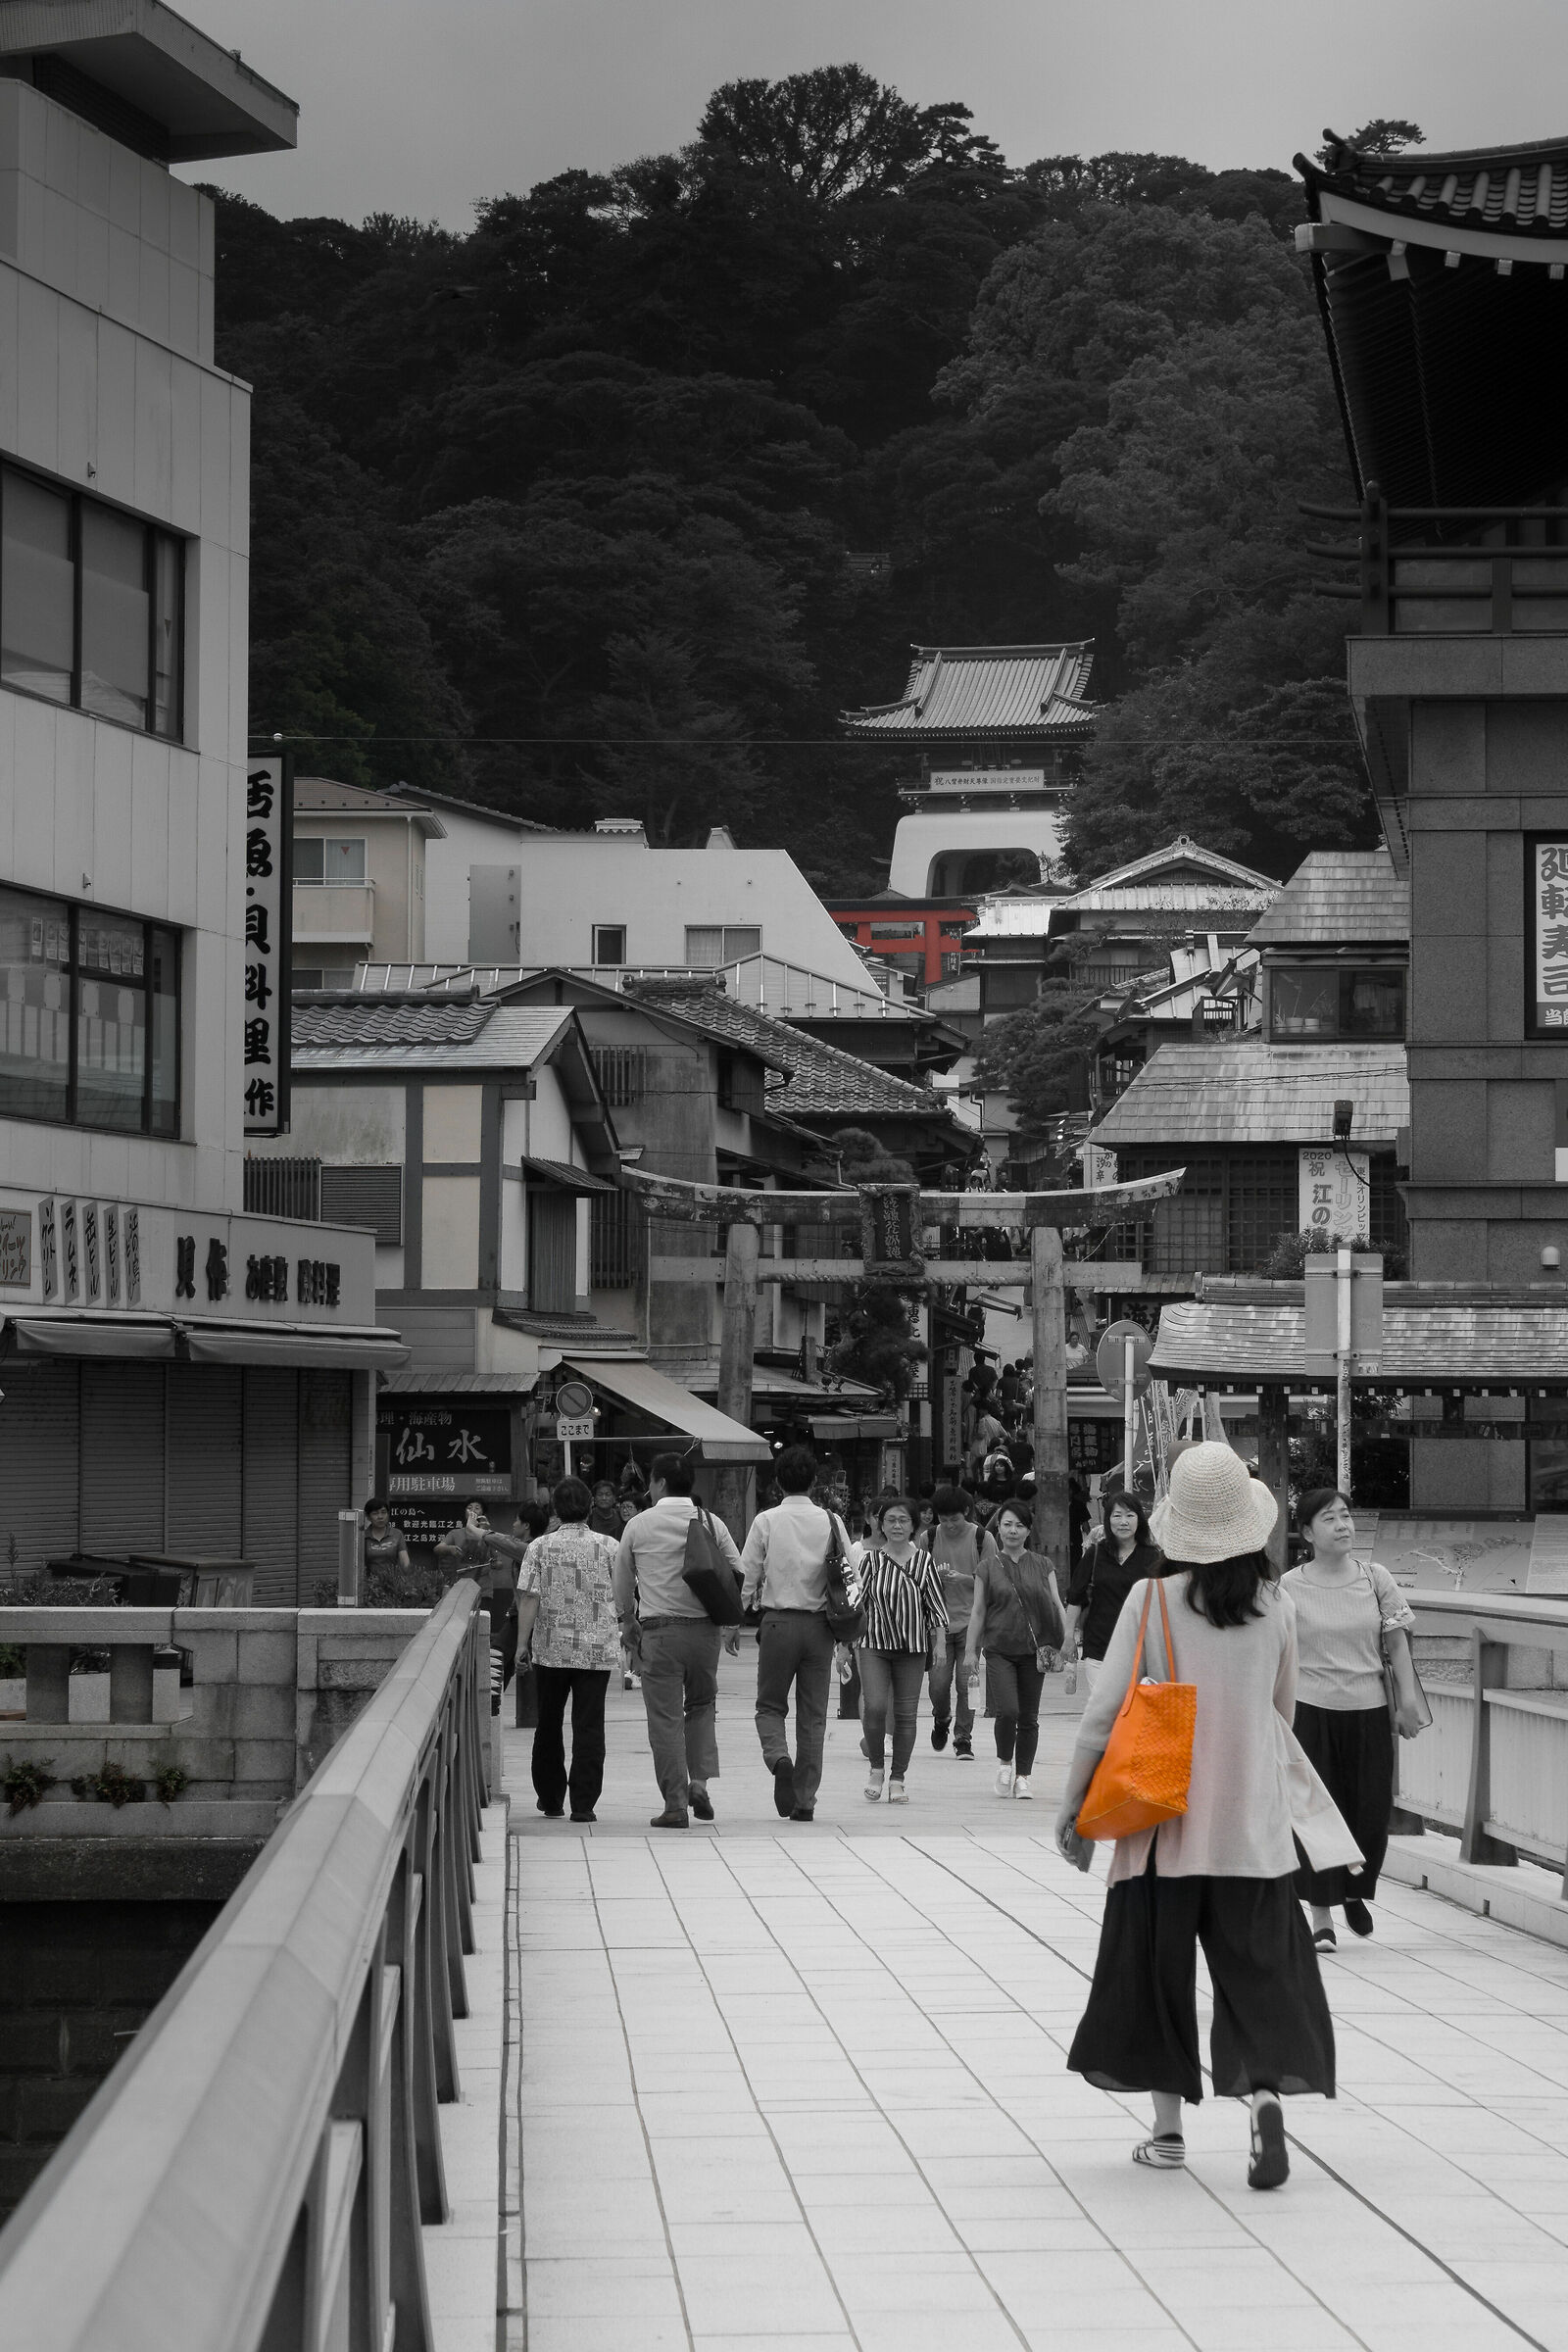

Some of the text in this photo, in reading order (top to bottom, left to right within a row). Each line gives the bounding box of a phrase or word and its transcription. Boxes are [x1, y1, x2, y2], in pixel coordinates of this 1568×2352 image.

[245, 1078, 275, 1117] 作
[1302, 1152, 1332, 1160] 2020
[1308, 1161, 1325, 1177] 祝
[0, 1232, 25, 1257] イーツ
[65, 1205, 76, 1294] ラムネ
[108, 1213, 119, 1299] 生ビール
[0, 1254, 27, 1280] リンク
[376, 1410, 453, 1426] 理・海産物
[561, 1425, 590, 1436] ここまで
[395, 1427, 488, 1465] 仙水
